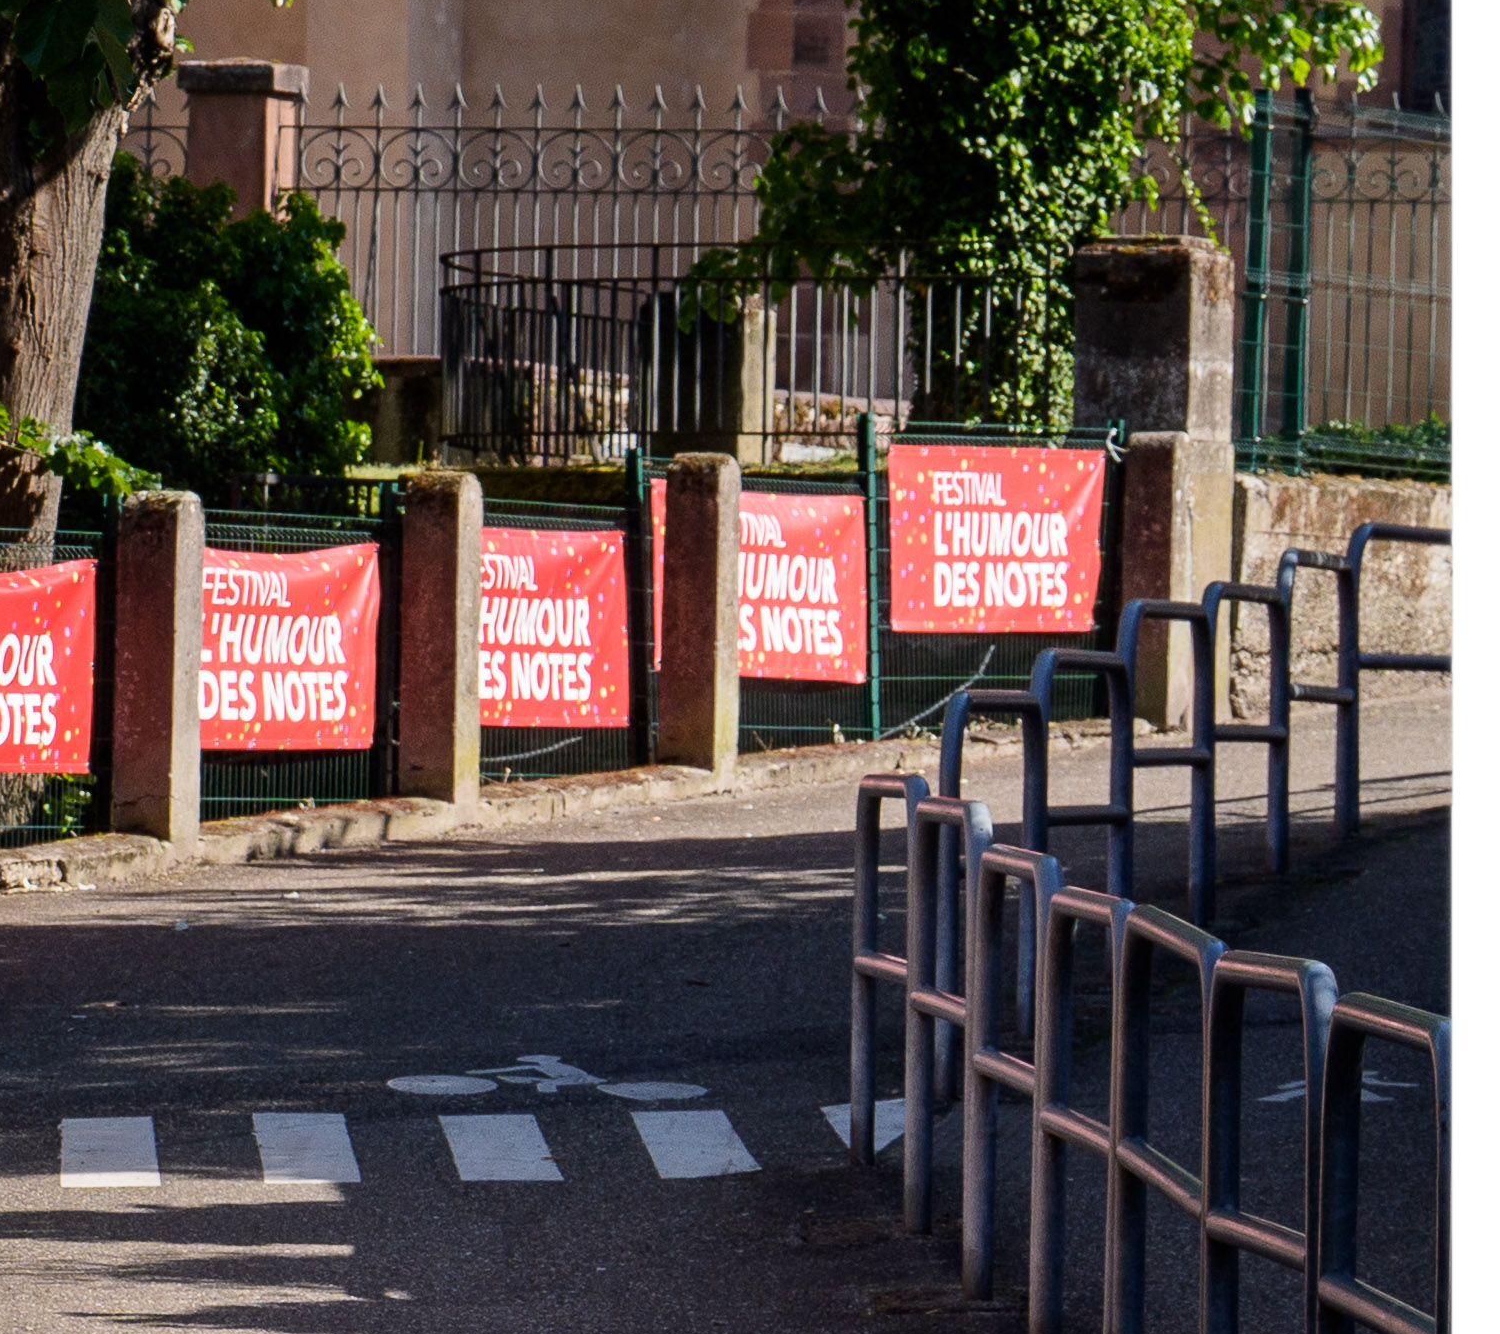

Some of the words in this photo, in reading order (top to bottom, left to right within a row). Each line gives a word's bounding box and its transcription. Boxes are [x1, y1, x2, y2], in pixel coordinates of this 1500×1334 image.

[933, 471, 1007, 506] FESTIVAL
[739, 511, 787, 548] TIVAL
[934, 510, 1068, 558] L'HUMOUR
[202, 567, 291, 608] FESTIVAL
[480, 553, 538, 591] STIVAL
[737, 552, 839, 604] UMOUR
[933, 561, 980, 607] DES
[984, 561, 1068, 607] NOTES
[478, 596, 592, 647] HUMOUR
[760, 605, 843, 656] NOTES
[198, 670, 256, 721] DES
[262, 670, 348, 722] NOTES
[478, 650, 507, 700] ES
[511, 651, 592, 701] NOTES
